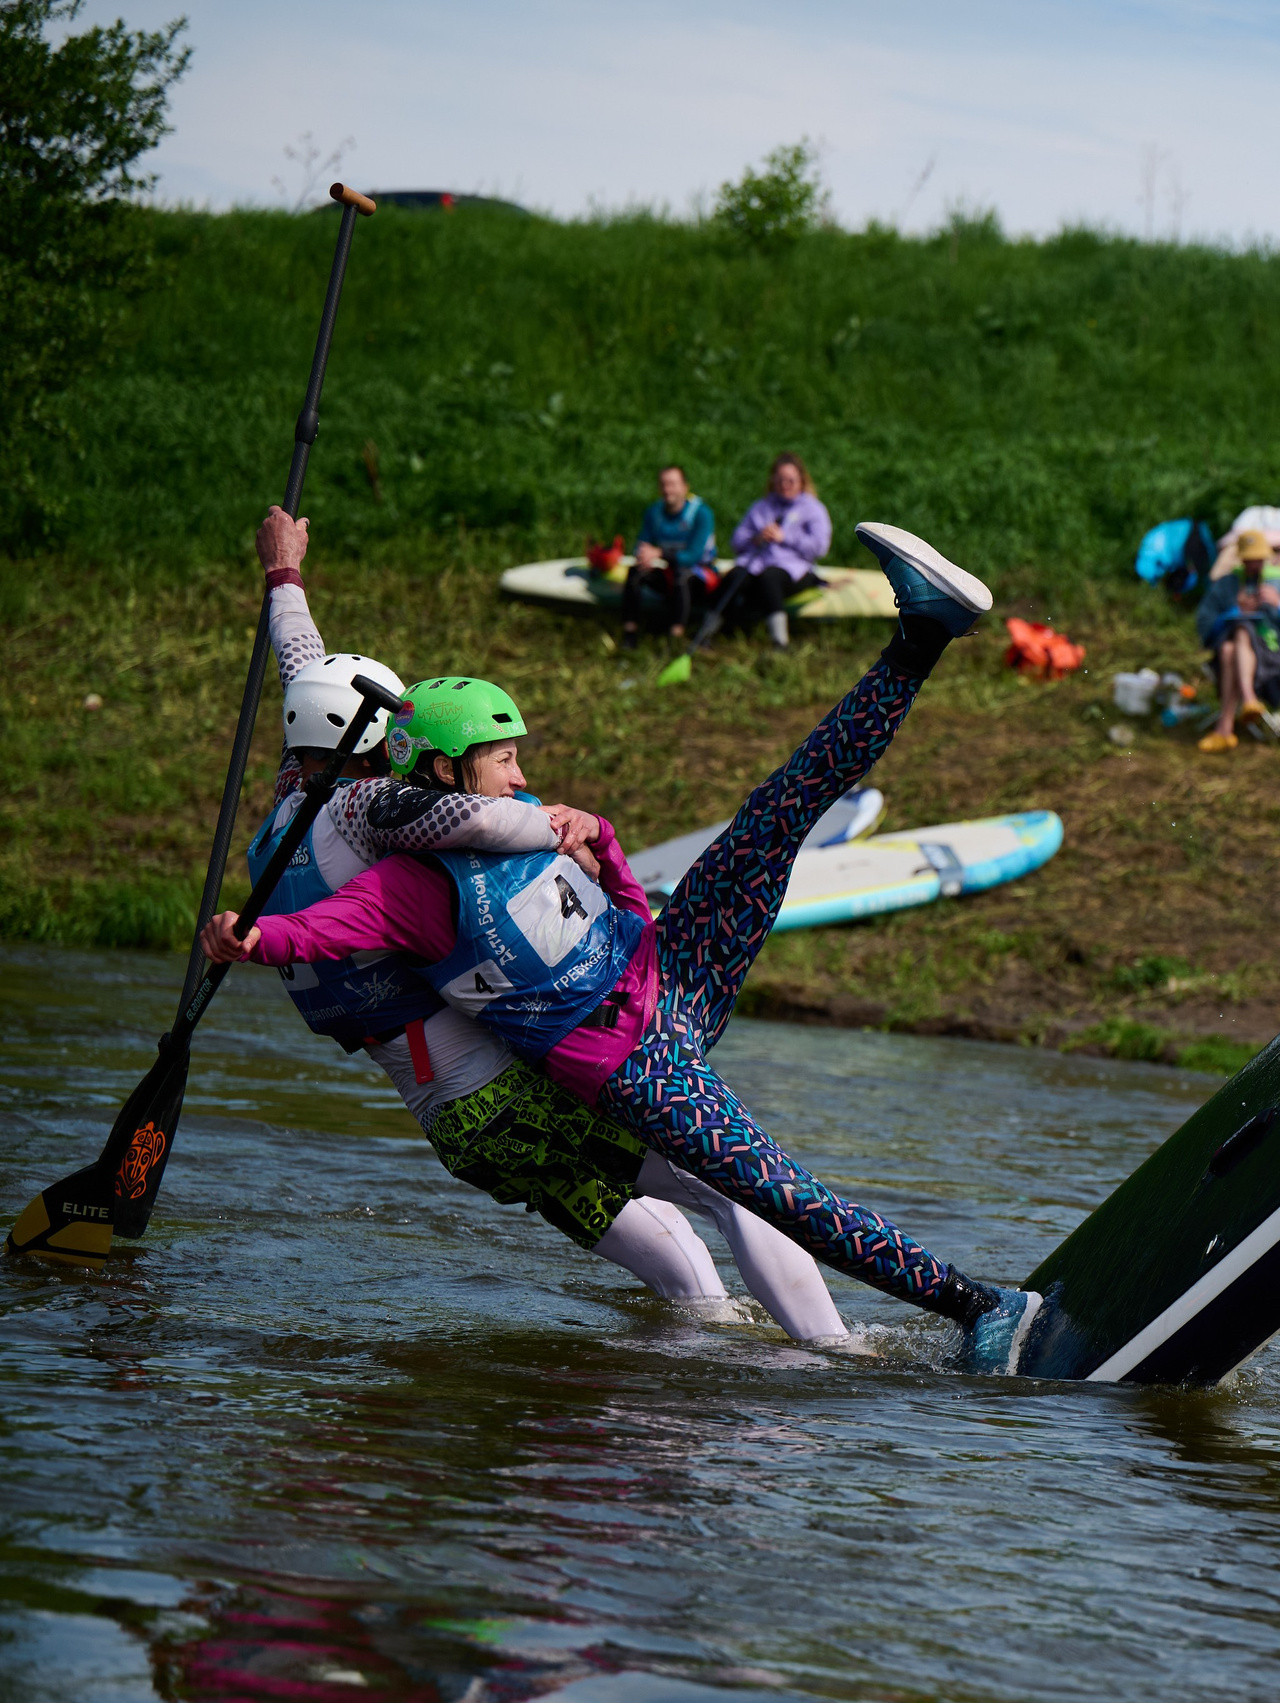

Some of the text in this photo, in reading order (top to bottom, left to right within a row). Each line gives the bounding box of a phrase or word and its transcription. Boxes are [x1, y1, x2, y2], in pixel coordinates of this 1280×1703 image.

[554, 874, 588, 921] 4
[475, 971, 496, 994] 4
[62, 1201, 110, 1219] ELITE
